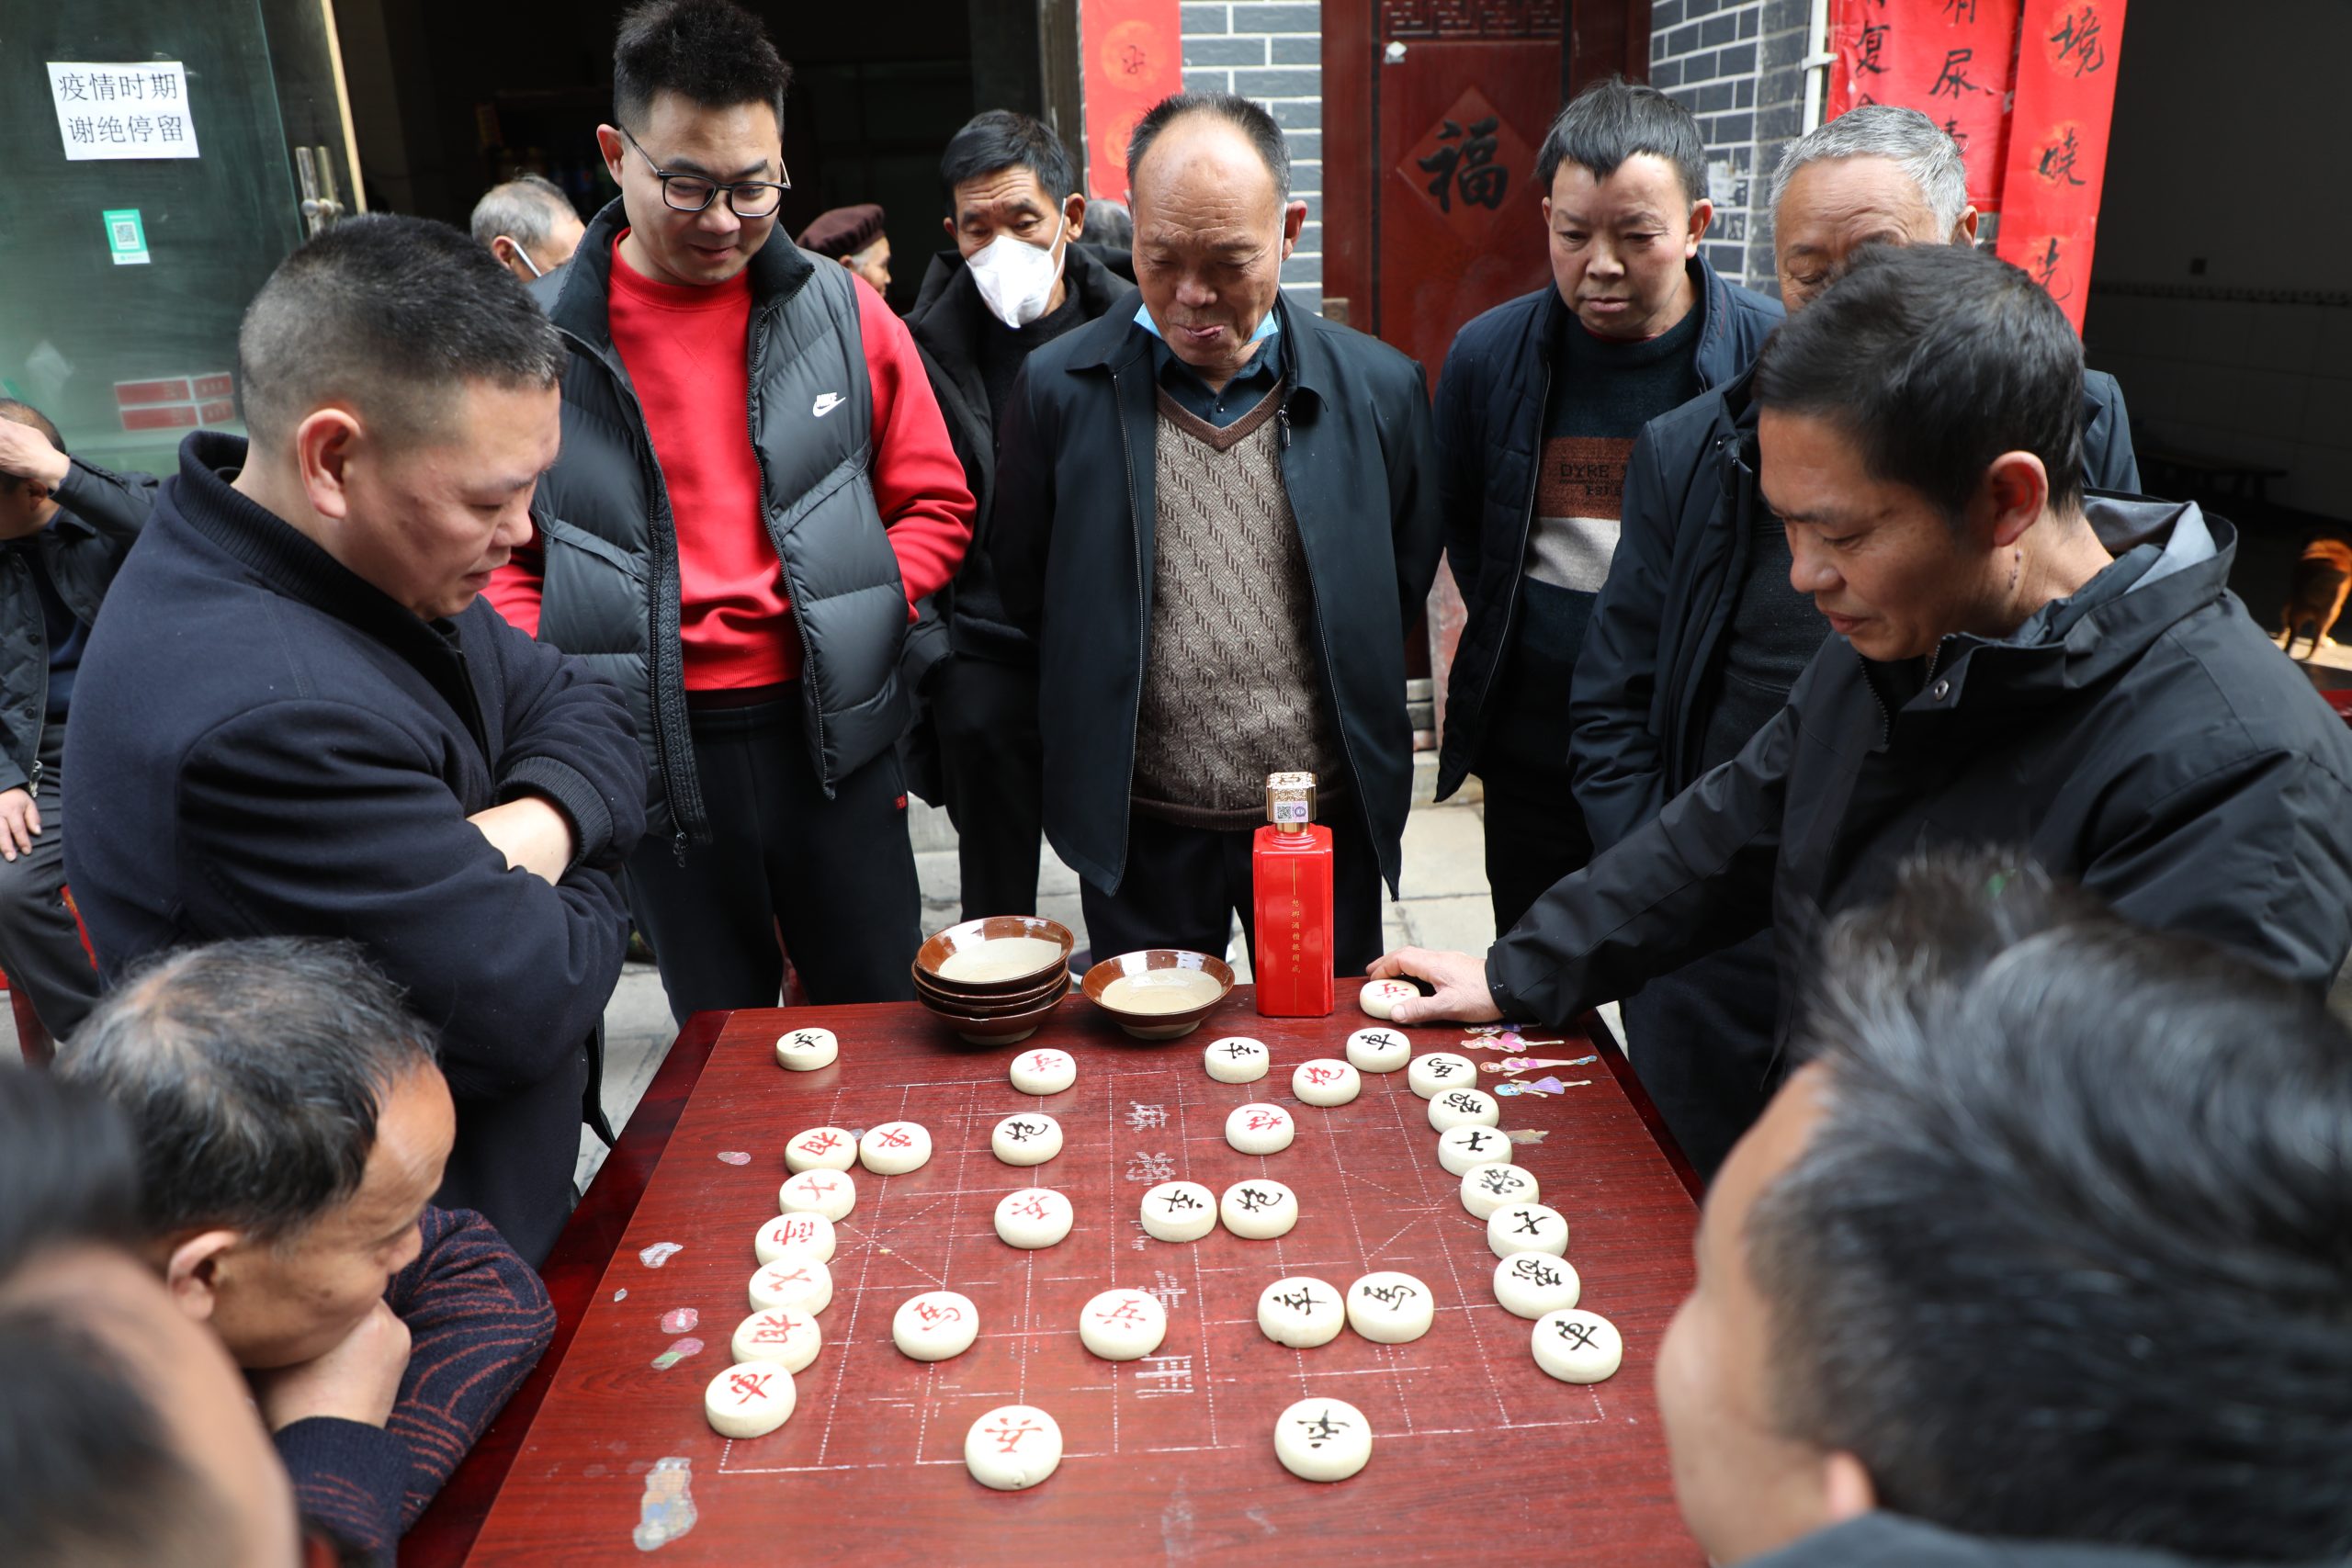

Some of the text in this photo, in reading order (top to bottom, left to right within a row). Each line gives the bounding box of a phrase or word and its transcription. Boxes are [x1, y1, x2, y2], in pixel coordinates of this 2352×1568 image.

[59, 73, 178, 101] 疫情时期
[67, 115, 184, 143] 谢绝停留
[1418, 116, 1509, 214] 福
[1378, 983, 1409, 998] 兵
[1028, 1055, 1062, 1072] 兵
[798, 1133, 842, 1156] 相
[1012, 1196, 1049, 1220] 兵
[1096, 1301, 1145, 1328] 兵
[751, 1315, 801, 1344] 相
[985, 1418, 1042, 1452] 兵
